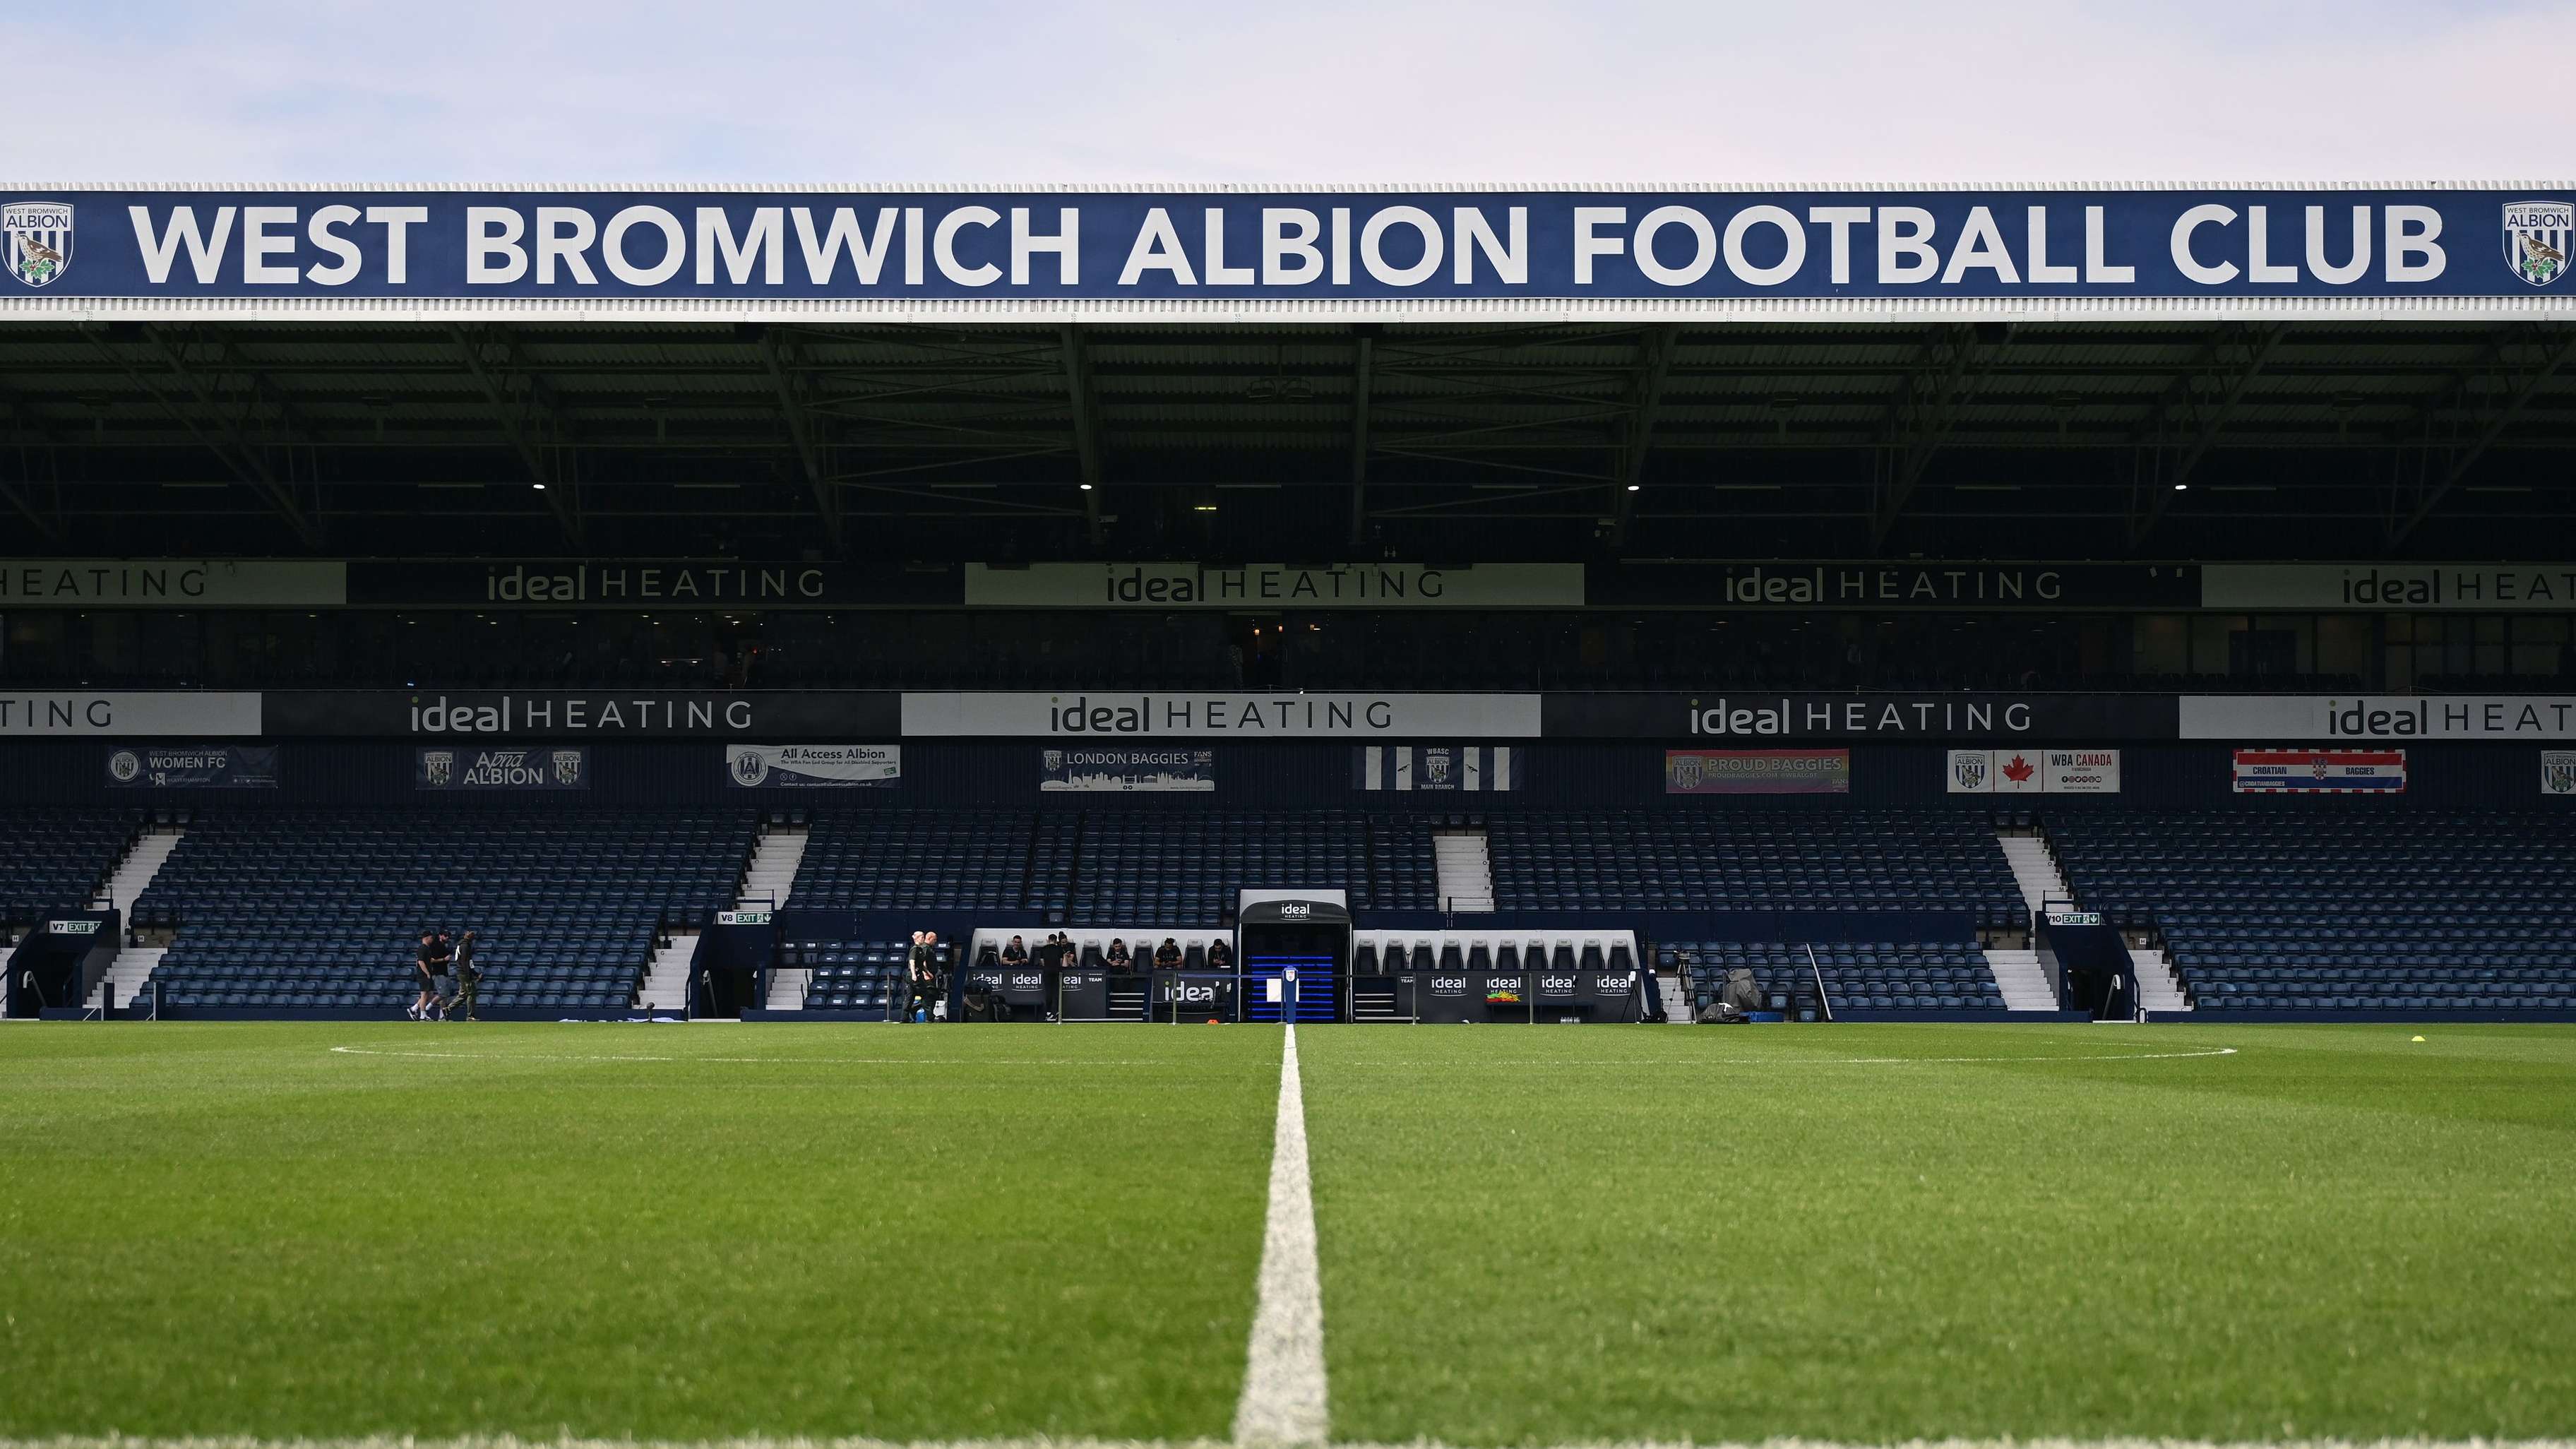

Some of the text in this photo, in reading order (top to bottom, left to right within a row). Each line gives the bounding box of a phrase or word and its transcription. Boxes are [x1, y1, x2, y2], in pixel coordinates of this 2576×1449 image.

[6, 215, 68, 228] ALBION
[2508, 214, 2569, 227] ALBION
[129, 204, 2445, 286] WEST BROMWICH ALBION FOOTBALL CLUB
[0, 569, 205, 597] EATING
[489, 565, 824, 601] ideal HEATING
[1108, 567, 1443, 602] ideal HEATING
[1727, 567, 2061, 602] ideal HEATING
[2344, 569, 2440, 604] ideal
[412, 696, 752, 732] ideal HEATING
[1051, 696, 1392, 732] ideal HEATING
[1691, 699, 2031, 734] ideal HEATING
[2330, 700, 2572, 735] ideal HEAT
[782, 749, 886, 759] All Access Albion
[1067, 753, 1127, 764] LONDON
[1131, 753, 1188, 764] BAGGIES
[2051, 754, 2112, 766] WBA CANADA
[149, 757, 226, 769] WOMEN FC
[476, 751, 527, 776] Apna
[1707, 758, 1842, 771] PROUD BAGGIES
[463, 768, 543, 785] ALBION
[2346, 767, 2375, 775] BAGGIES
[1282, 904, 1310, 914] ideal
[737, 914, 756, 922] EXIT
[68, 923, 87, 931] EXIT
[1013, 974, 1042, 984] ideal
[1431, 977, 1466, 989] ideal
[1486, 977, 1521, 989] ideal
[1597, 975, 1631, 988] ideal
